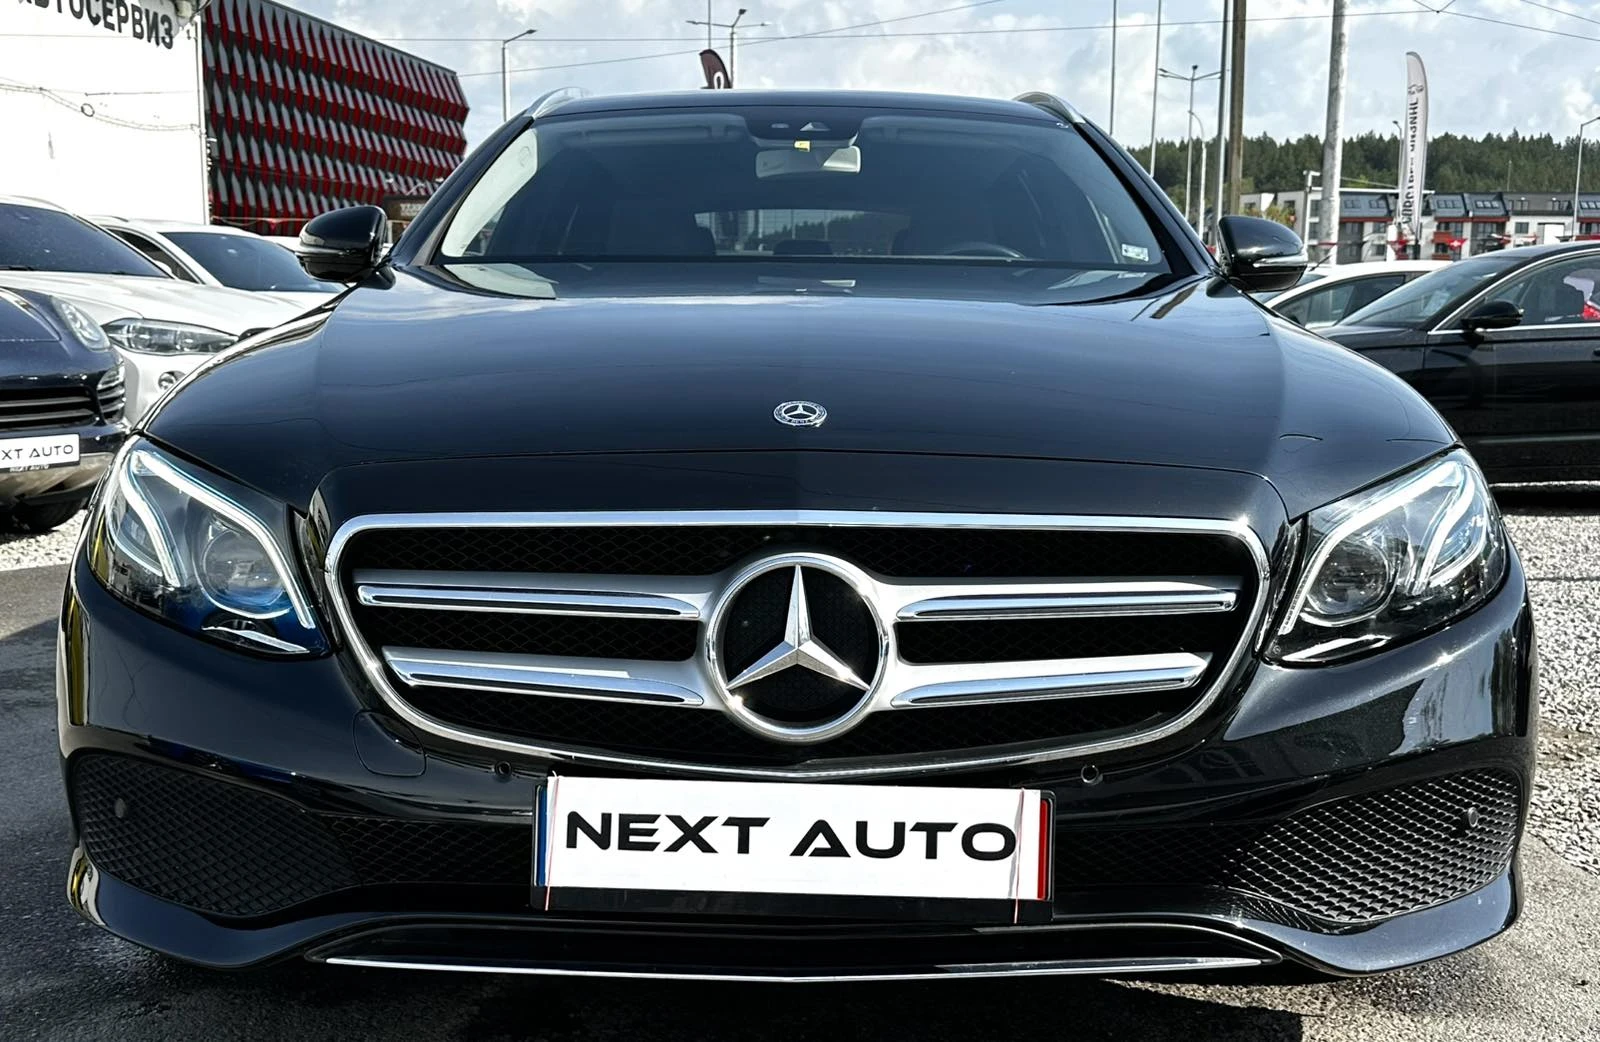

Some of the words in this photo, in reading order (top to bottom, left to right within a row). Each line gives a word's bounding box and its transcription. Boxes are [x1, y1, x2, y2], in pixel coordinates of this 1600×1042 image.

[18, 0, 174, 50] ОСЕРВИЗ
[28, 444, 74, 459] AUTO
[566, 810, 771, 855] NEXT
[789, 819, 1017, 862] AUTO
